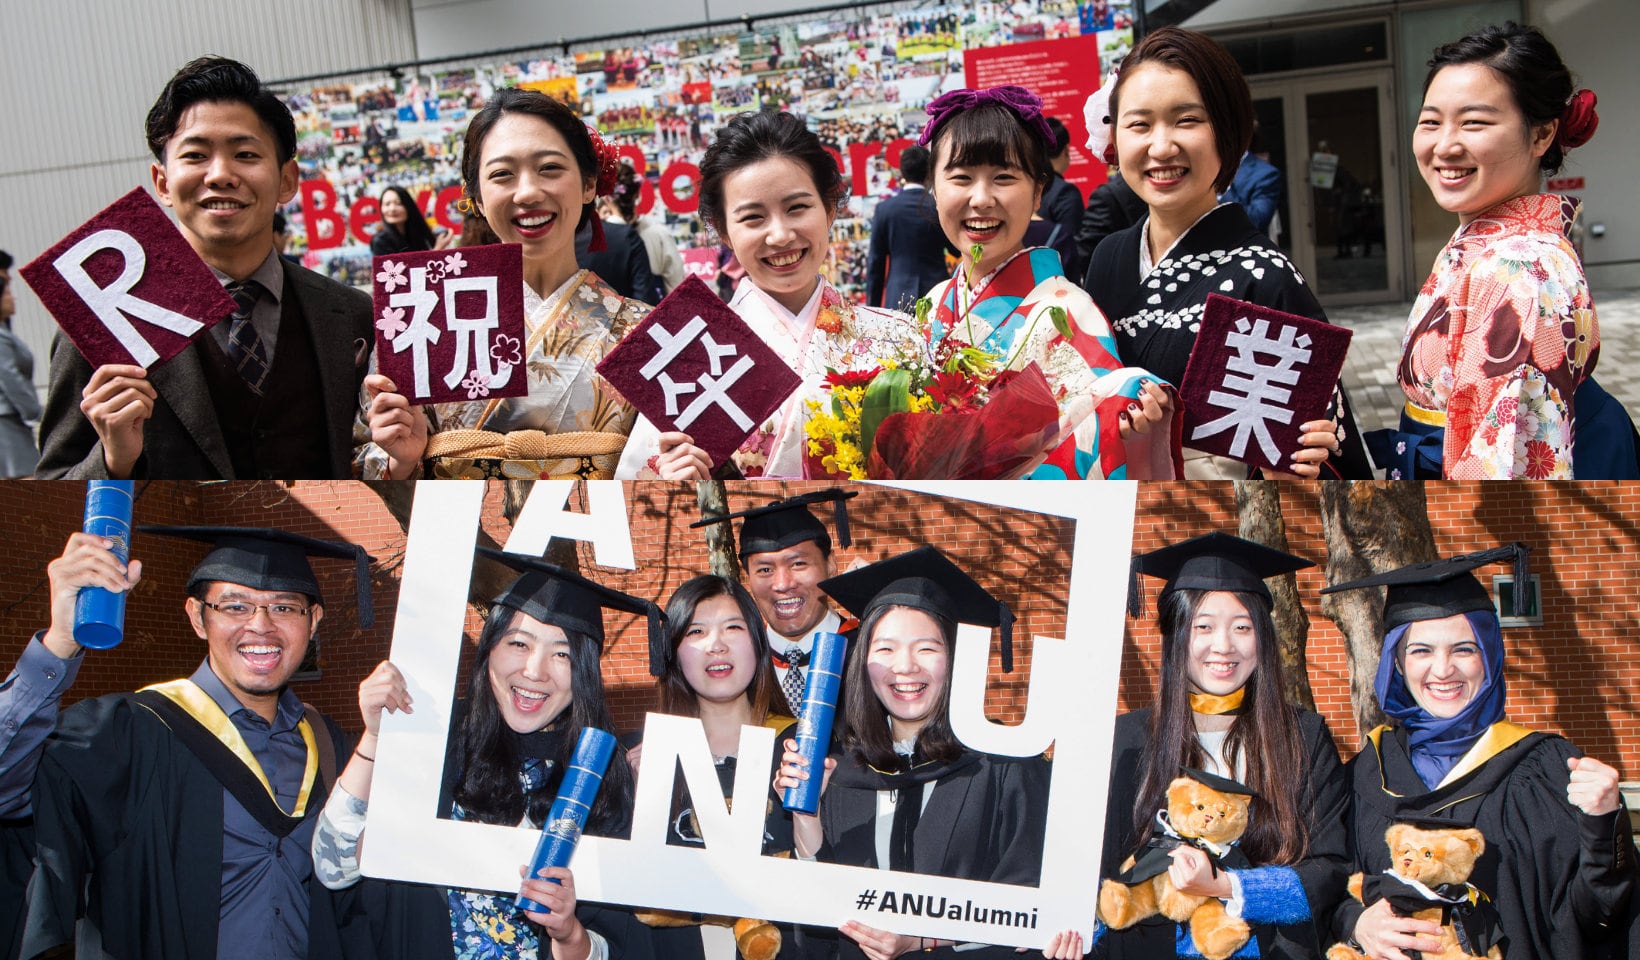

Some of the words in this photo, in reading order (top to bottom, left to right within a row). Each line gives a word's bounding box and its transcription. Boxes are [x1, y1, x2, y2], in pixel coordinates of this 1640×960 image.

[53, 229, 205, 369] R
[390, 267, 513, 398] 祝
[639, 316, 755, 432] 卒
[1192, 317, 1312, 465] 業
[856, 889, 1038, 929] #ANUalumni
